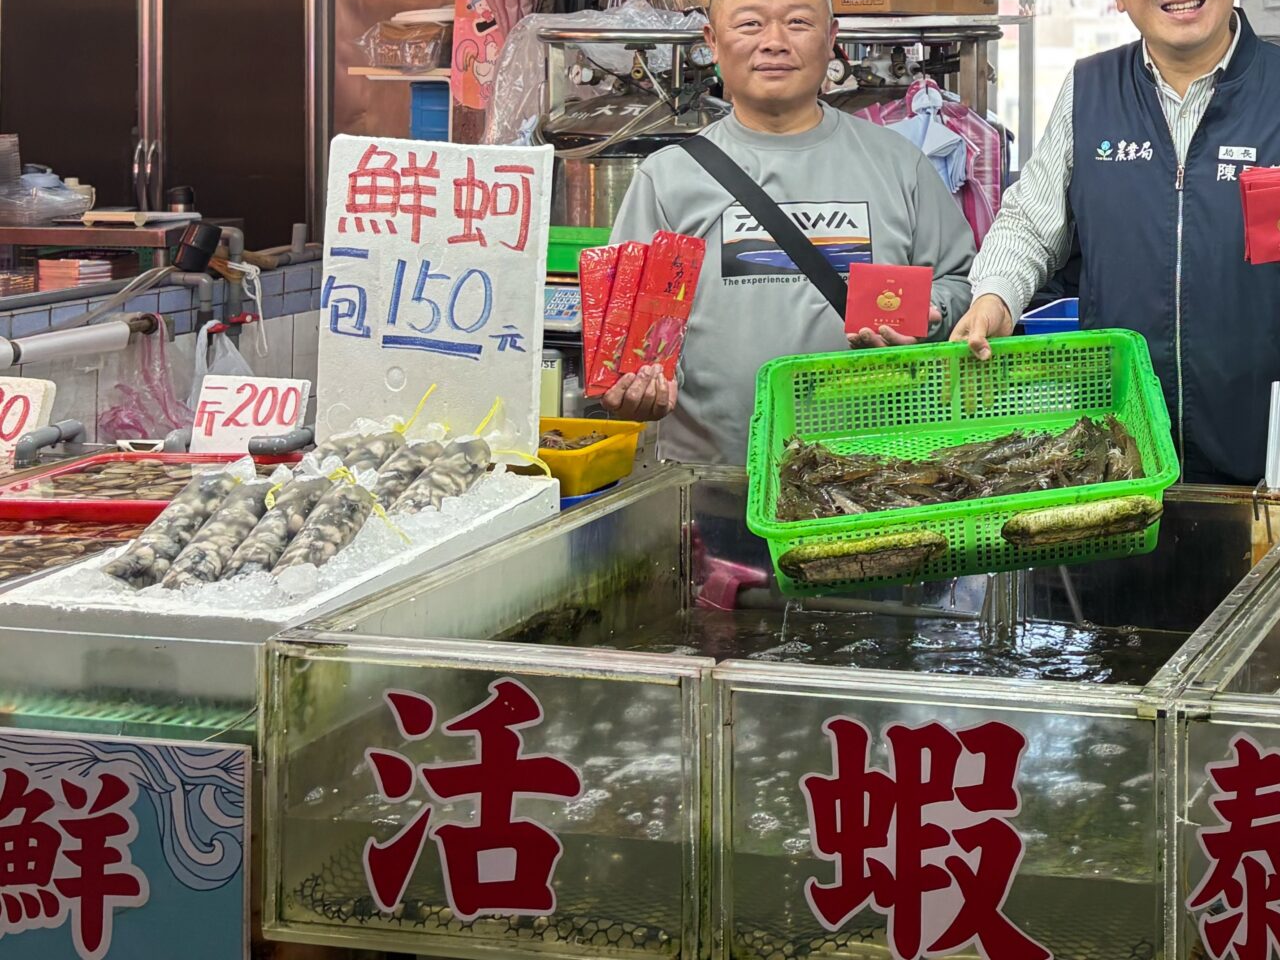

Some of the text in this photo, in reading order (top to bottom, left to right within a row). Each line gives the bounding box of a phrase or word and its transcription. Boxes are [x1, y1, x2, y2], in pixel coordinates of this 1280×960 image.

[1223, 148, 1253, 159] 局長
[337, 144, 534, 252] 鮮蚵
[723, 278, 739, 286] The
[741, 276, 790, 286] experience
[387, 259, 494, 333] 150
[489, 325, 526, 352] 元
[221, 383, 301, 428] 200
